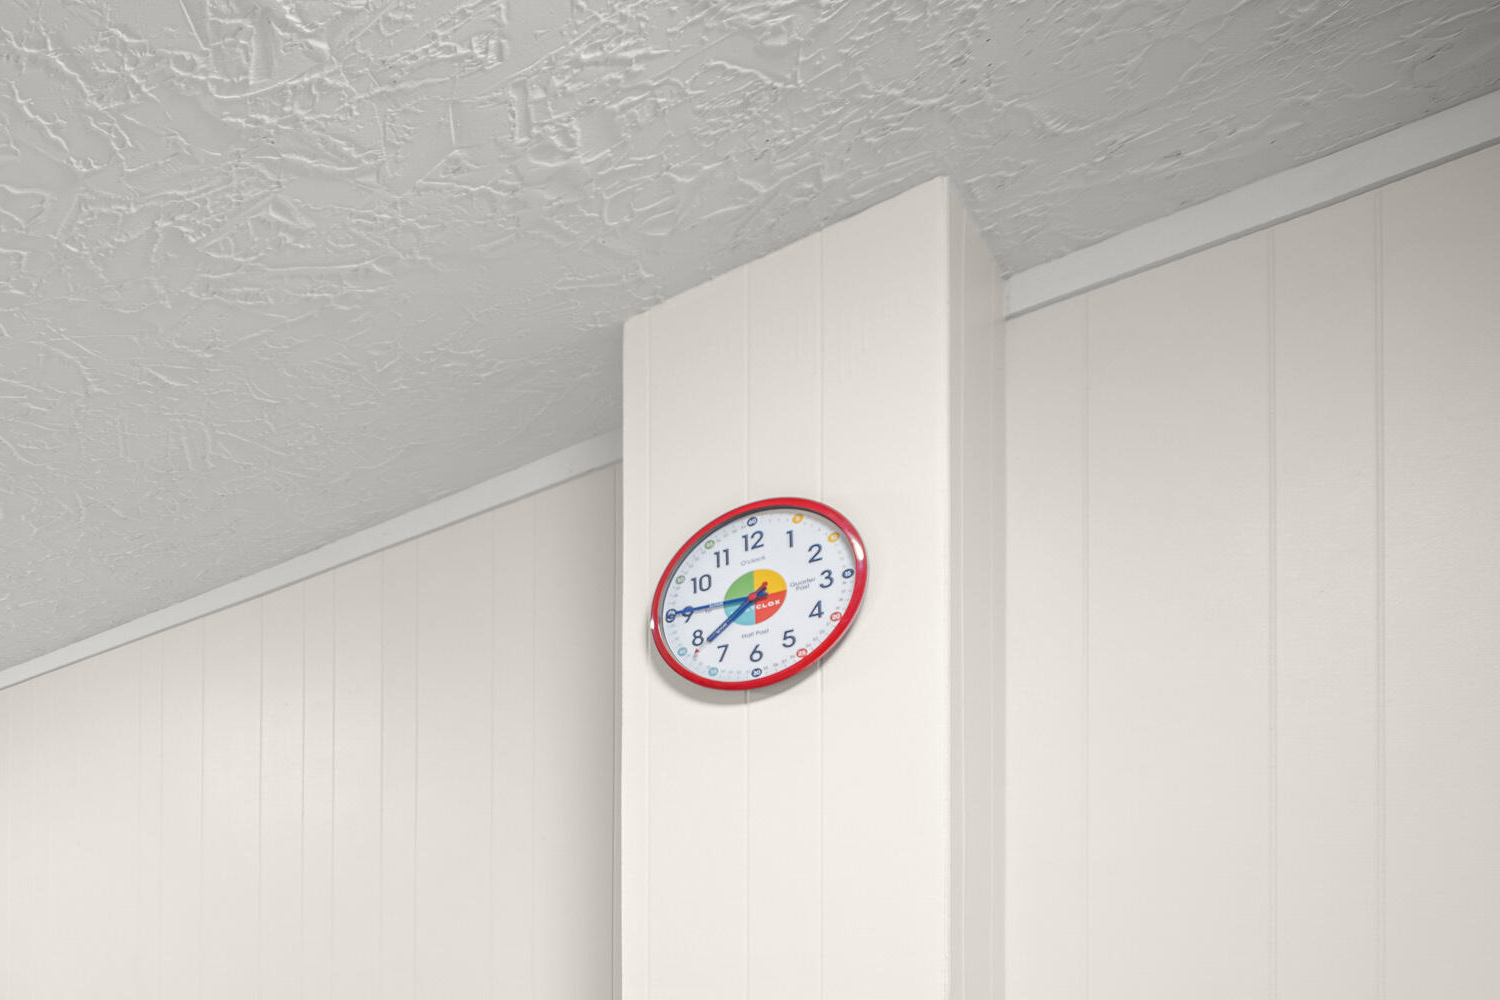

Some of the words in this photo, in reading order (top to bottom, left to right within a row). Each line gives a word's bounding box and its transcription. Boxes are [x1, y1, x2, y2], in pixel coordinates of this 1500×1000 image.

[741, 530, 765, 552] 12
[786, 530, 794, 548] 1
[713, 548, 730, 568] 11
[807, 544, 823, 563] 2
[690, 574, 712, 594] 10
[790, 577, 816, 588] Quarter
[819, 569, 834, 588] 3
[681, 606, 694, 623] 9
[808, 600, 824, 618] 4
[691, 629, 704, 647] 8
[755, 628, 770, 636] Past
[781, 629, 796, 648] 5
[717, 643, 729, 663] 7
[749, 643, 764, 662] 6
